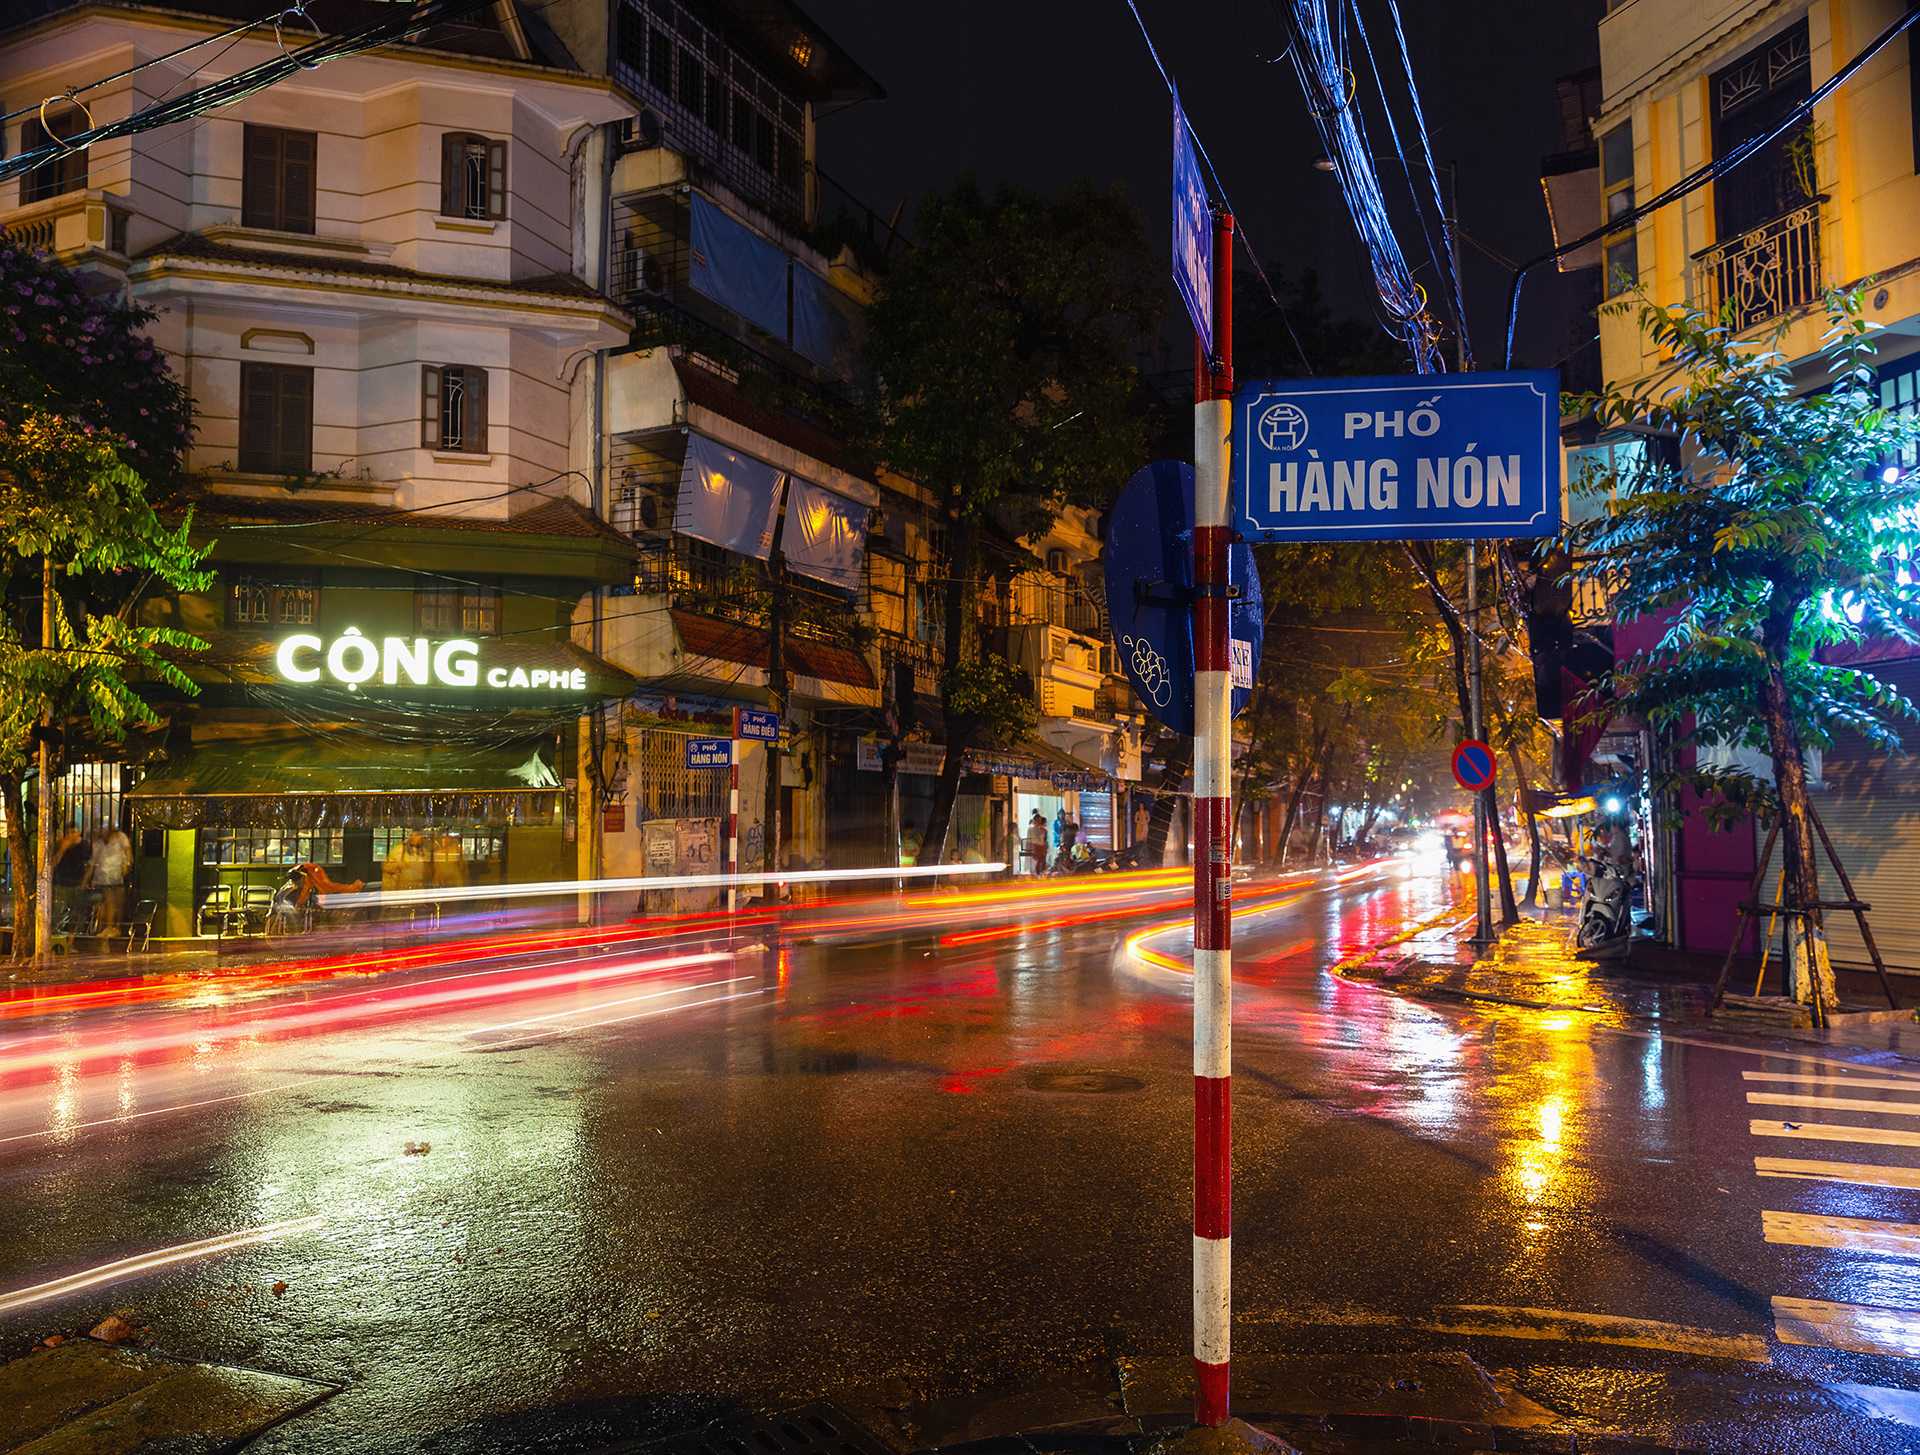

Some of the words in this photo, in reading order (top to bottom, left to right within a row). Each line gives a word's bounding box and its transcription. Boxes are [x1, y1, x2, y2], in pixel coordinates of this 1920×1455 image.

[1187, 170, 1202, 233] PHỐ
[1178, 193, 1198, 297] HÀNG
[1344, 395, 1442, 439] PHỐ
[1269, 449, 1398, 512] HÀNG
[1416, 442, 1521, 509] NÓN
[276, 626, 479, 692] CỘNG
[1231, 646, 1251, 667] XE
[743, 721, 760, 735] HÀNG
[752, 715, 767, 724] PHỐ
[690, 751, 711, 765] HÀNG
[712, 750, 728, 764] NÓN
[701, 742, 718, 752] PHỐ
